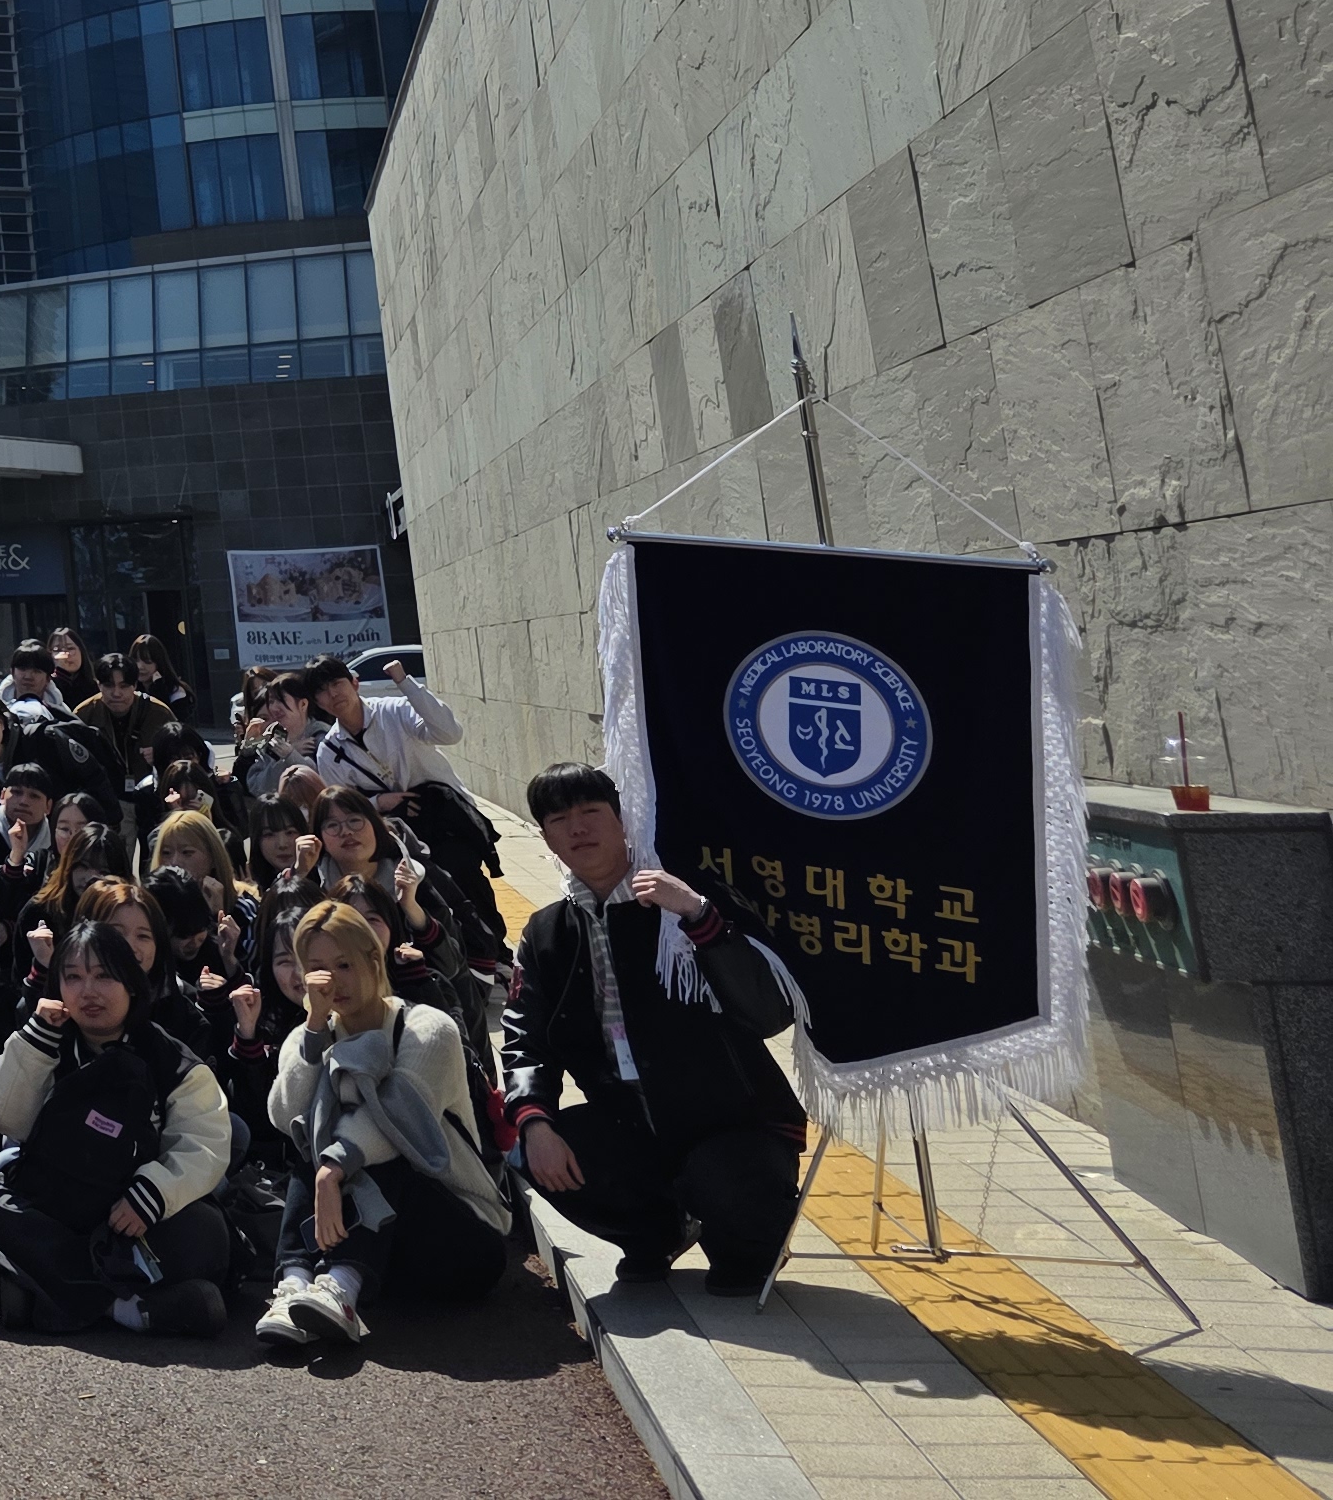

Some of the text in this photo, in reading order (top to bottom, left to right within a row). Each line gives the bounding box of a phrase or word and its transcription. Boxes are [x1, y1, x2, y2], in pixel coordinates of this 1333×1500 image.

[324, 630, 344, 644] Le
[347, 627, 381, 647] pain
[739, 640, 915, 712] MEDICAL LABORATORY SCIENCE
[736, 718, 920, 811] SEOYEONG 1978 UNIVERSITY
[698, 846, 980, 924] 서영대학교
